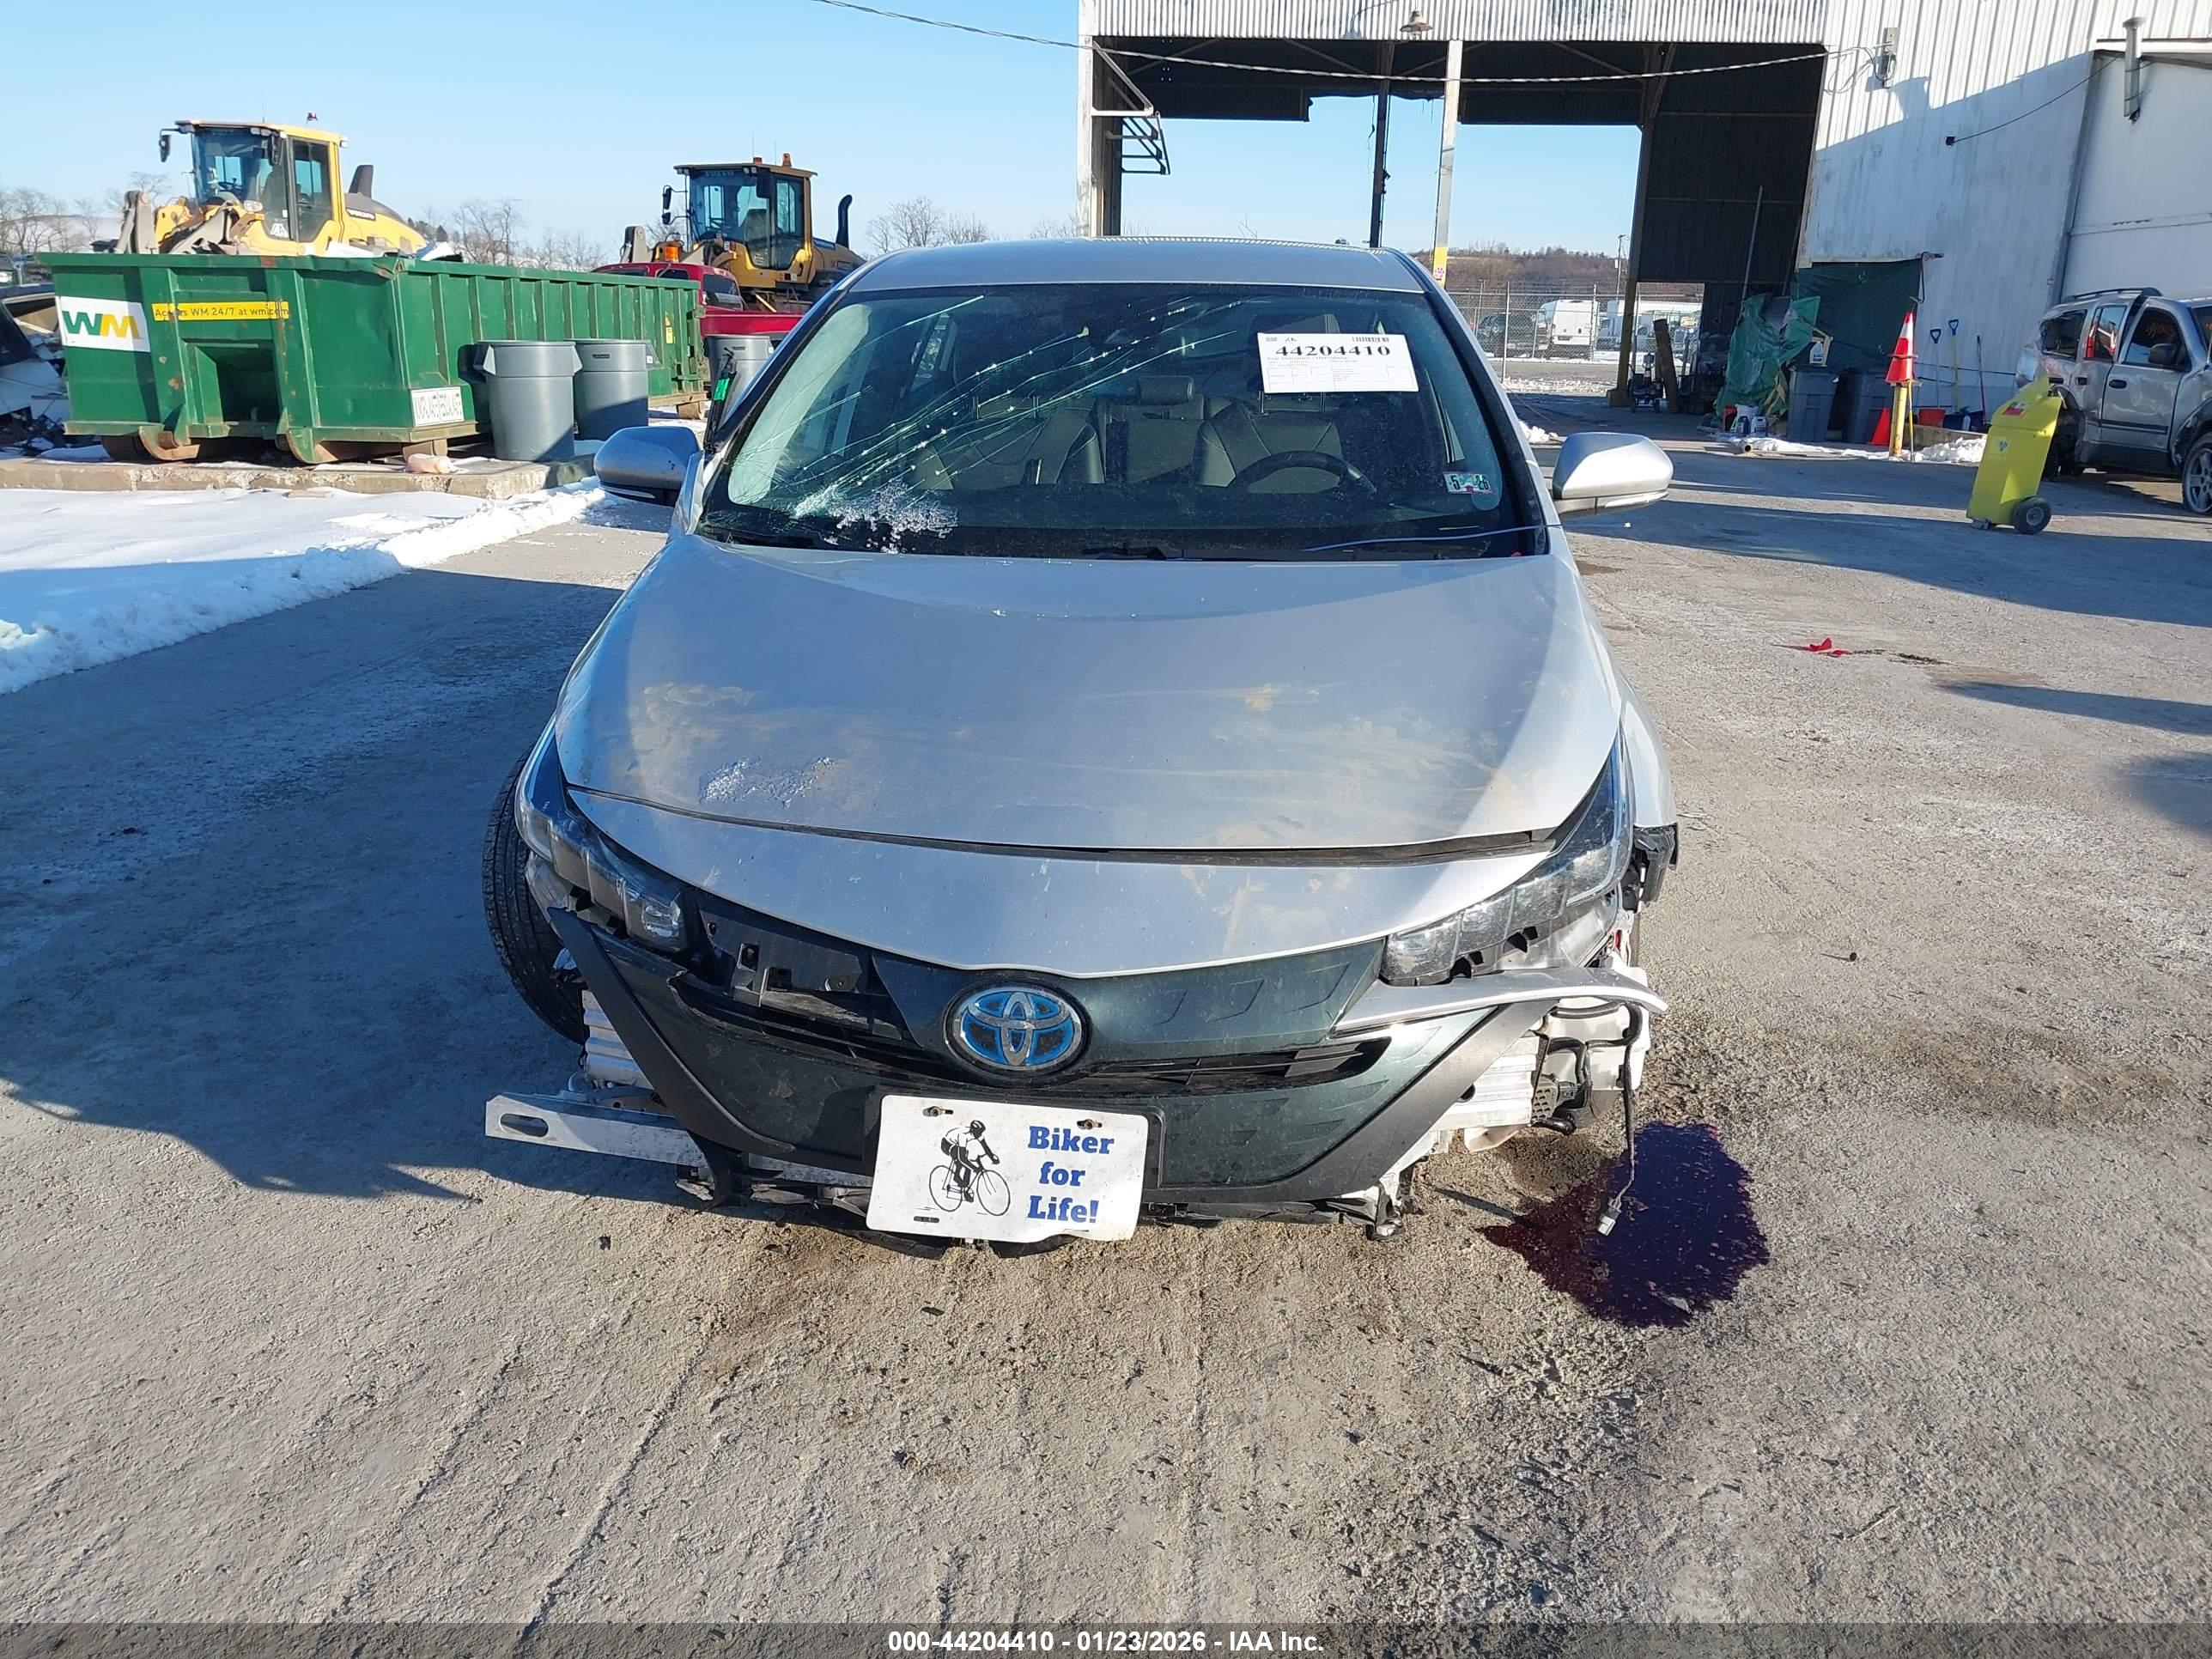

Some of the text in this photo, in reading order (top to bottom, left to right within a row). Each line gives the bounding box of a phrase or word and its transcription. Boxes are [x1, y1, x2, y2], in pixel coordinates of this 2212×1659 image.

[62, 310, 142, 340] WM
[212, 307, 234, 317] 24/7
[1275, 345, 1390, 356] 44204410
[1027, 1126, 1115, 1154] Biker
[1039, 1160, 1085, 1187] for
[1027, 1195, 1100, 1224] Life!
